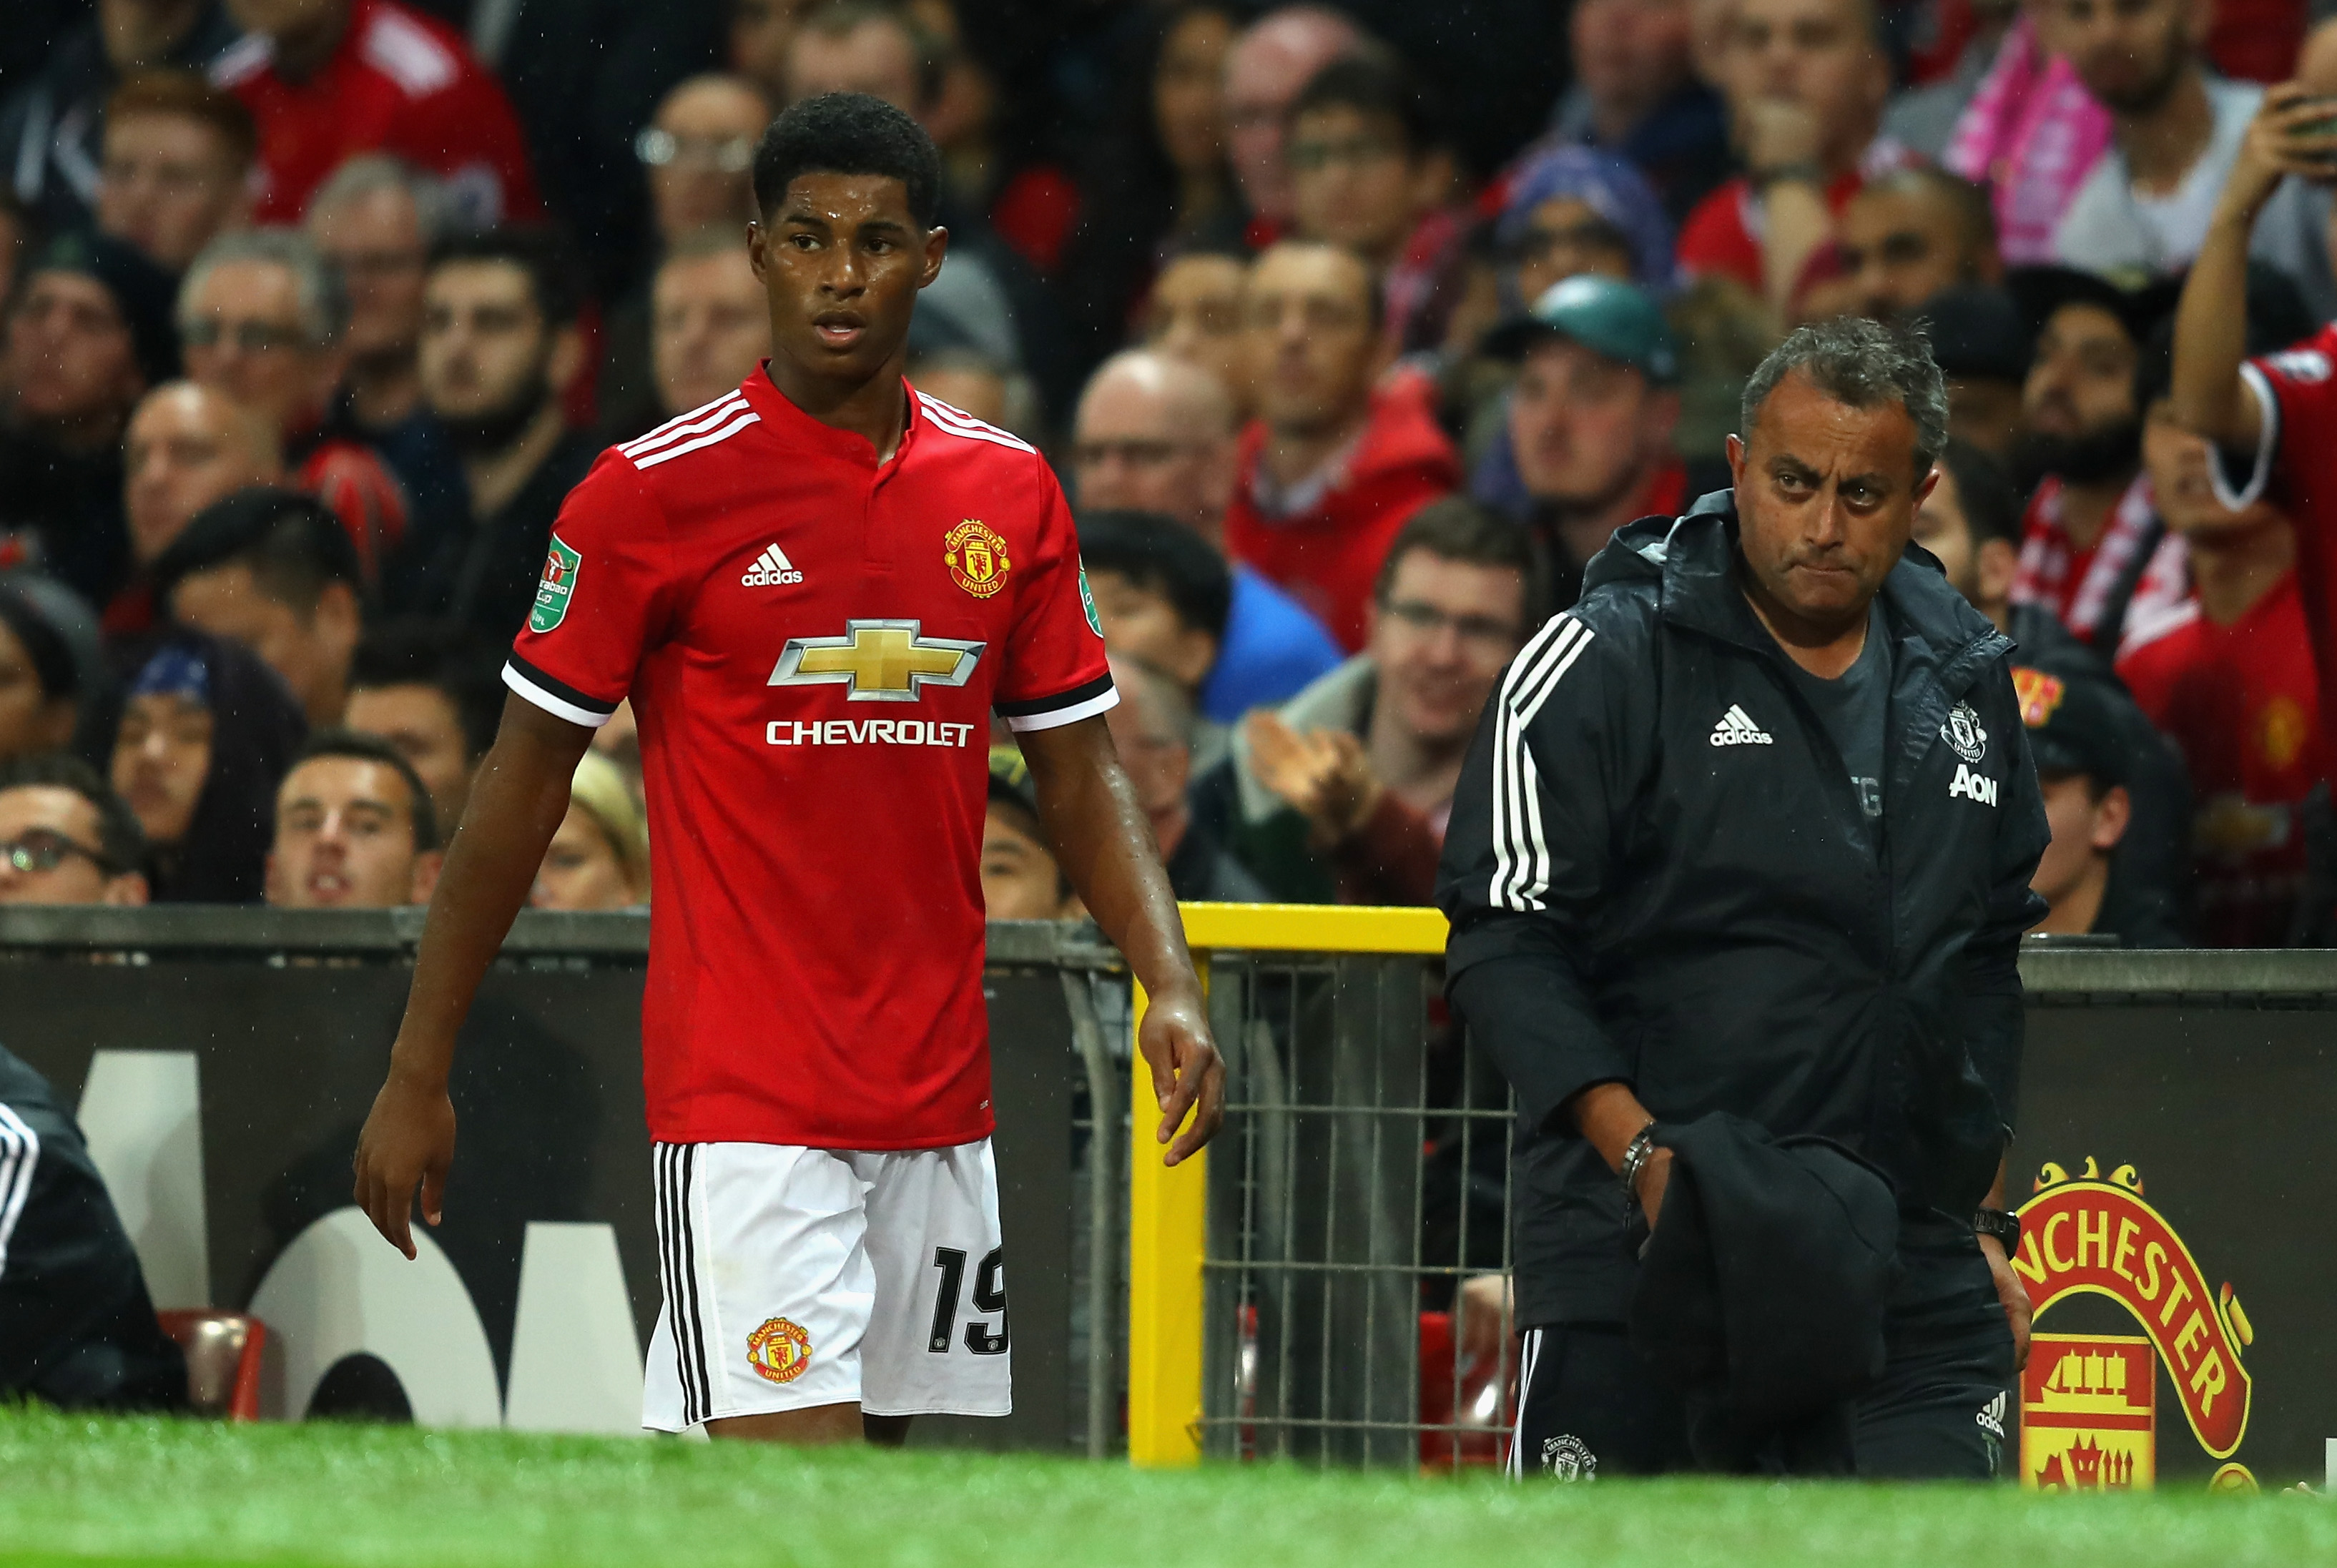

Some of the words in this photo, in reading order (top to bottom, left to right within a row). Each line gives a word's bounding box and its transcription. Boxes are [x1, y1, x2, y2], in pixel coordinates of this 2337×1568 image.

[950, 524, 1002, 552] MANCHESTER
[539, 579, 568, 595] rabao
[741, 568, 803, 587] adidas
[963, 578, 998, 593] UNITED
[766, 719, 975, 747] CHEVROLET
[1710, 727, 1773, 746] adidas
[1850, 776, 1882, 817] G
[928, 1244, 1010, 1355] 19
[2010, 1209, 2227, 1418] NCHESTER
[752, 1323, 803, 1346] MANCHESTER
[764, 1366, 801, 1379] UNITED
